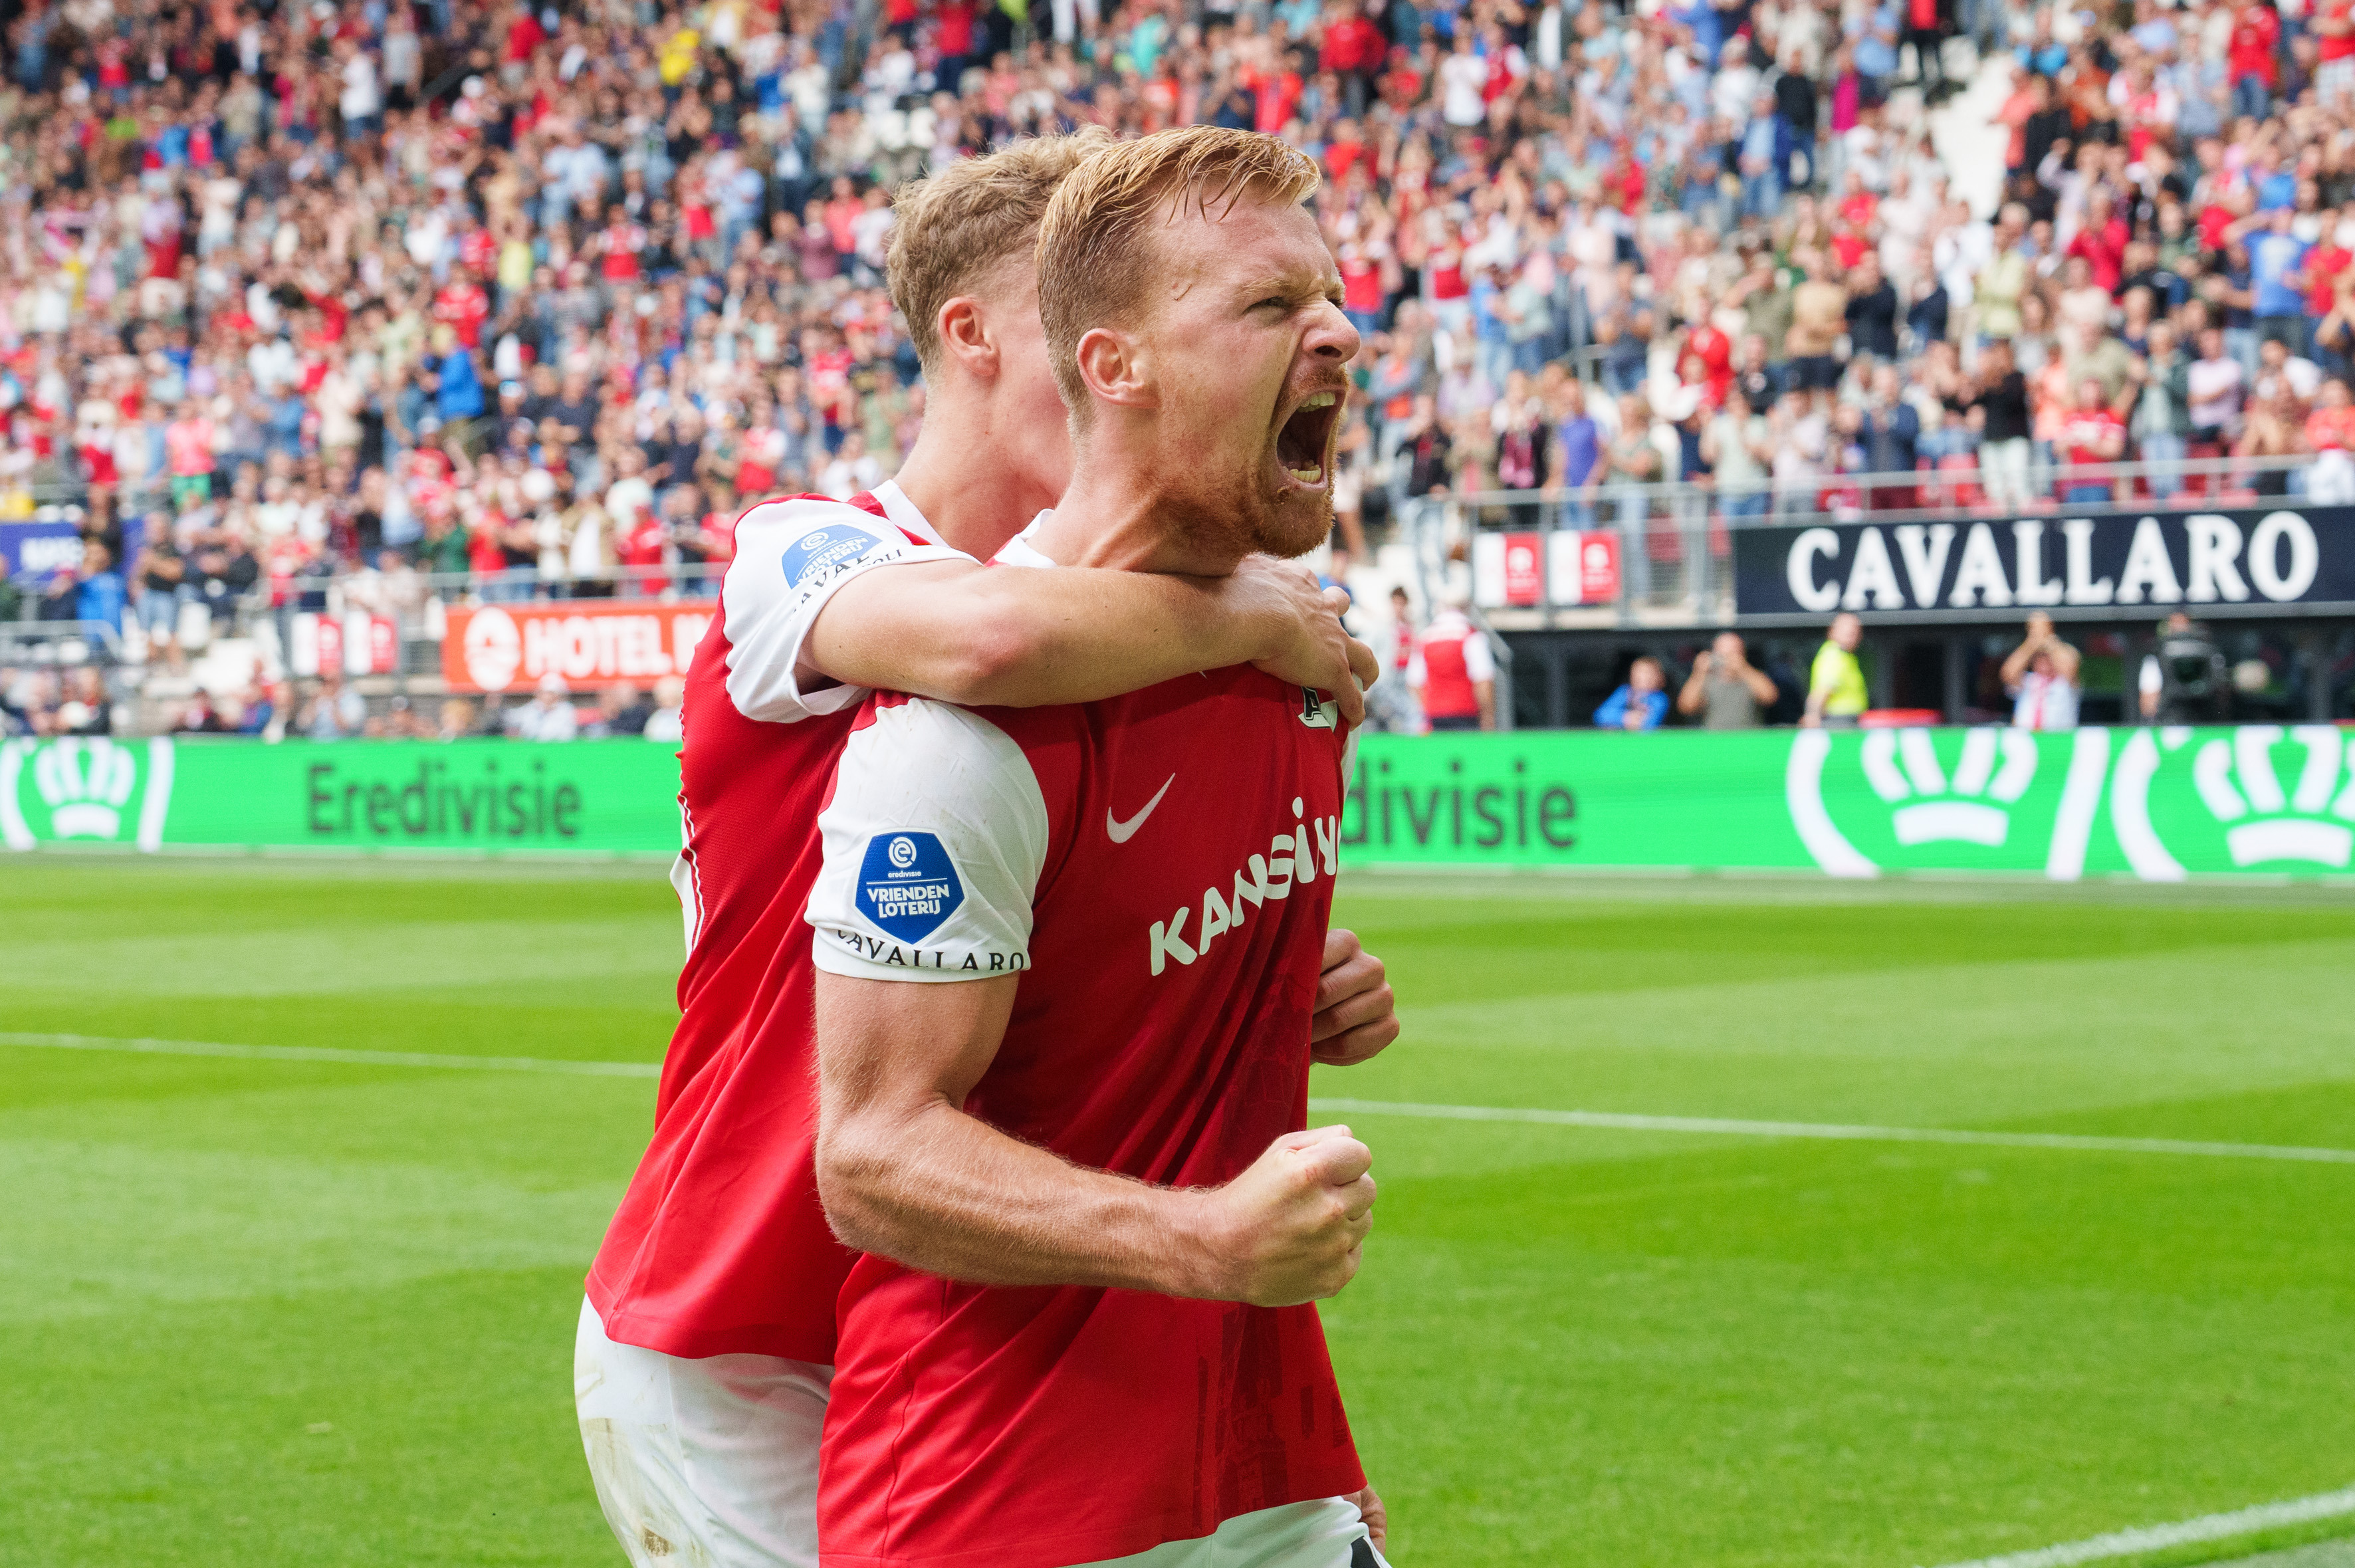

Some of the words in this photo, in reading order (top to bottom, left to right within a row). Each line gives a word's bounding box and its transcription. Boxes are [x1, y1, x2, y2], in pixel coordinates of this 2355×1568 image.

[814, 544, 863, 574] OTERIJ
[1786, 510, 2320, 612] CAVALLARO
[524, 615, 673, 678] HOTEL
[307, 758, 582, 838] Eredivisie
[1341, 757, 1577, 848] divisie
[867, 884, 950, 903] VRIENDEN
[879, 899, 941, 919] LOTERIJ
